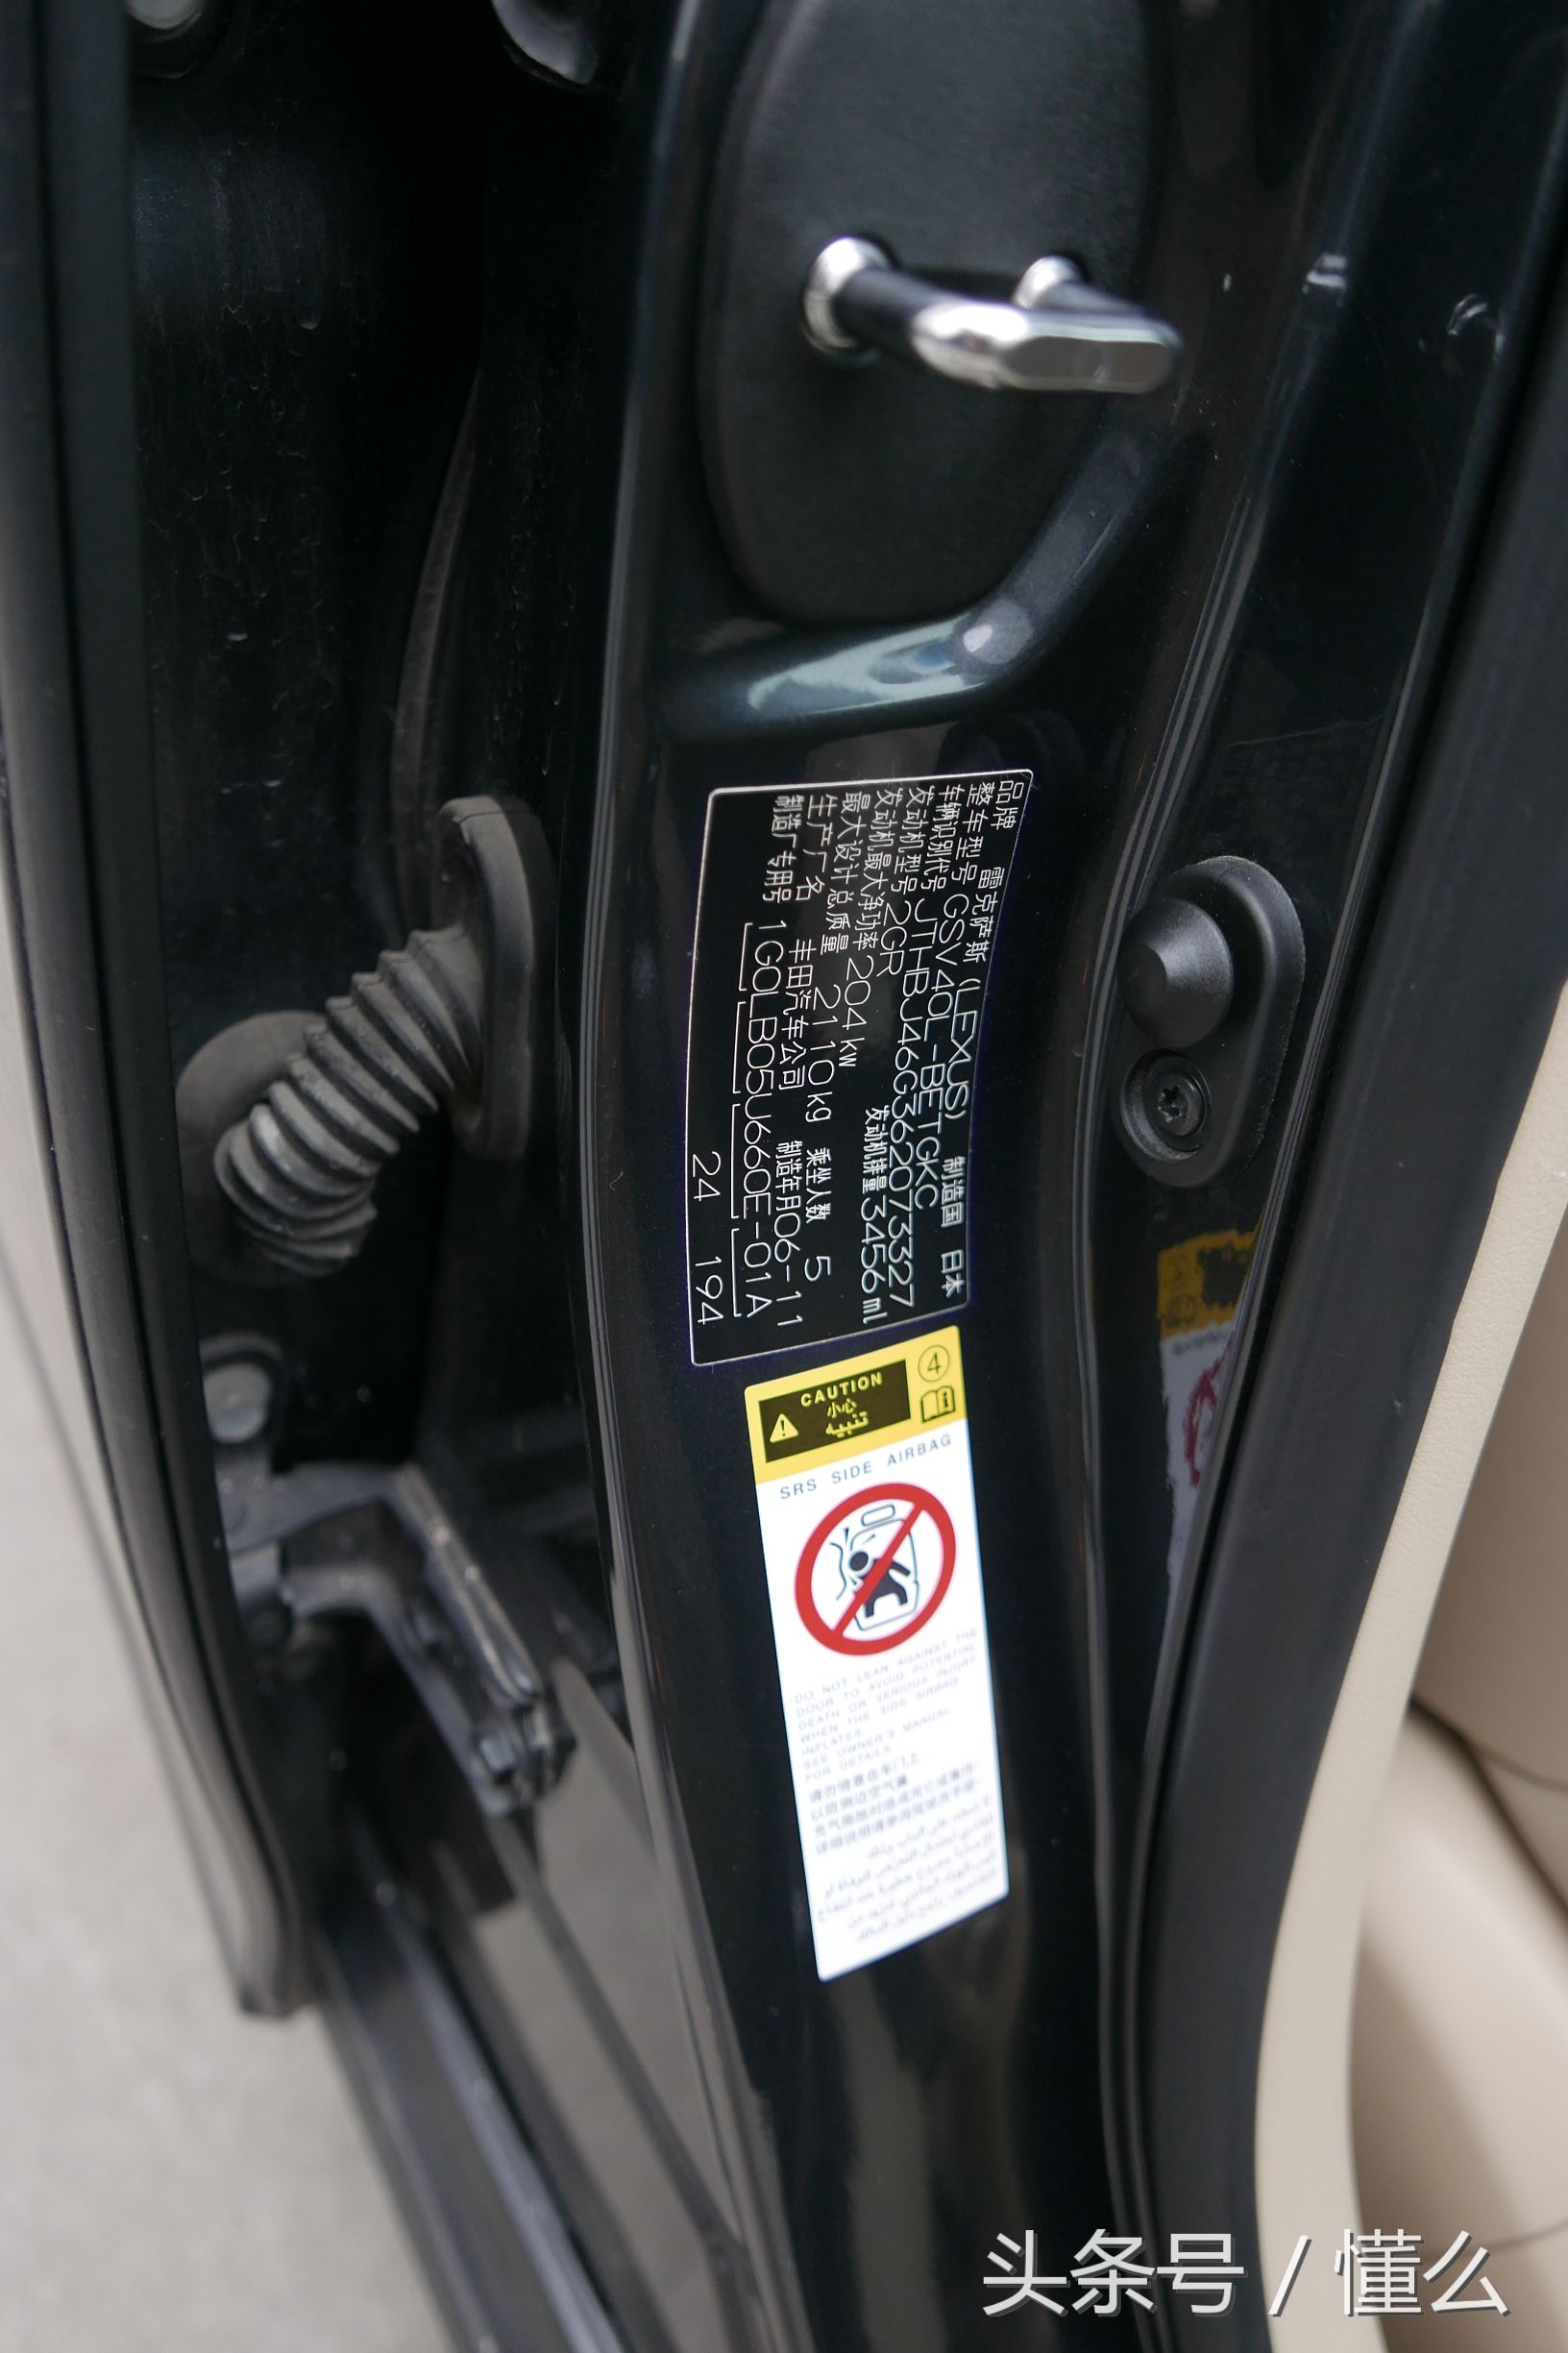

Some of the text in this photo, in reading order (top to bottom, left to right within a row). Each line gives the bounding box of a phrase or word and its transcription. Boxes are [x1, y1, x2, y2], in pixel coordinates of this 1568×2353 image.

[891, 785, 935, 895] 发动机型号
[920, 784, 965, 892] 车辆识别代号
[950, 782, 995, 885] 整车型号
[990, 780, 1024, 830] 品牌
[762, 795, 805, 903] 制造厂专用号
[795, 794, 838, 901] 生产厂名
[852, 789, 903, 951] 发动机最大净功率
[876, 900, 911, 977] 2GR
[963, 867, 1005, 963] 雷克萨斯
[778, 939, 816, 1091] 丰田汽车公司
[843, 955, 874, 1030] 204
[804, 792, 870, 1282] 最大设计总质量 2110 kg 乘坐人数 5
[774, 1140, 802, 1212] 制造年月
[862, 1105, 890, 1194] 发动机排量
[941, 1157, 965, 1228] 制造国
[693, 1151, 724, 1325] 24 194
[861, 1195, 886, 1294] 3456
[941, 1250, 964, 1298] 日本
[800, 1372, 883, 1407] CAUTION
[825, 1410, 870, 1439] تنبيه
[826, 1398, 858, 1418] 小心
[779, 1434, 952, 1500] SRS SIDE AIRBAG
[822, 1679, 848, 1693] NOT
[857, 1665, 889, 1682] LEAN
[844, 1690, 860, 1701] TO
[869, 1673, 904, 1692] AVOID
